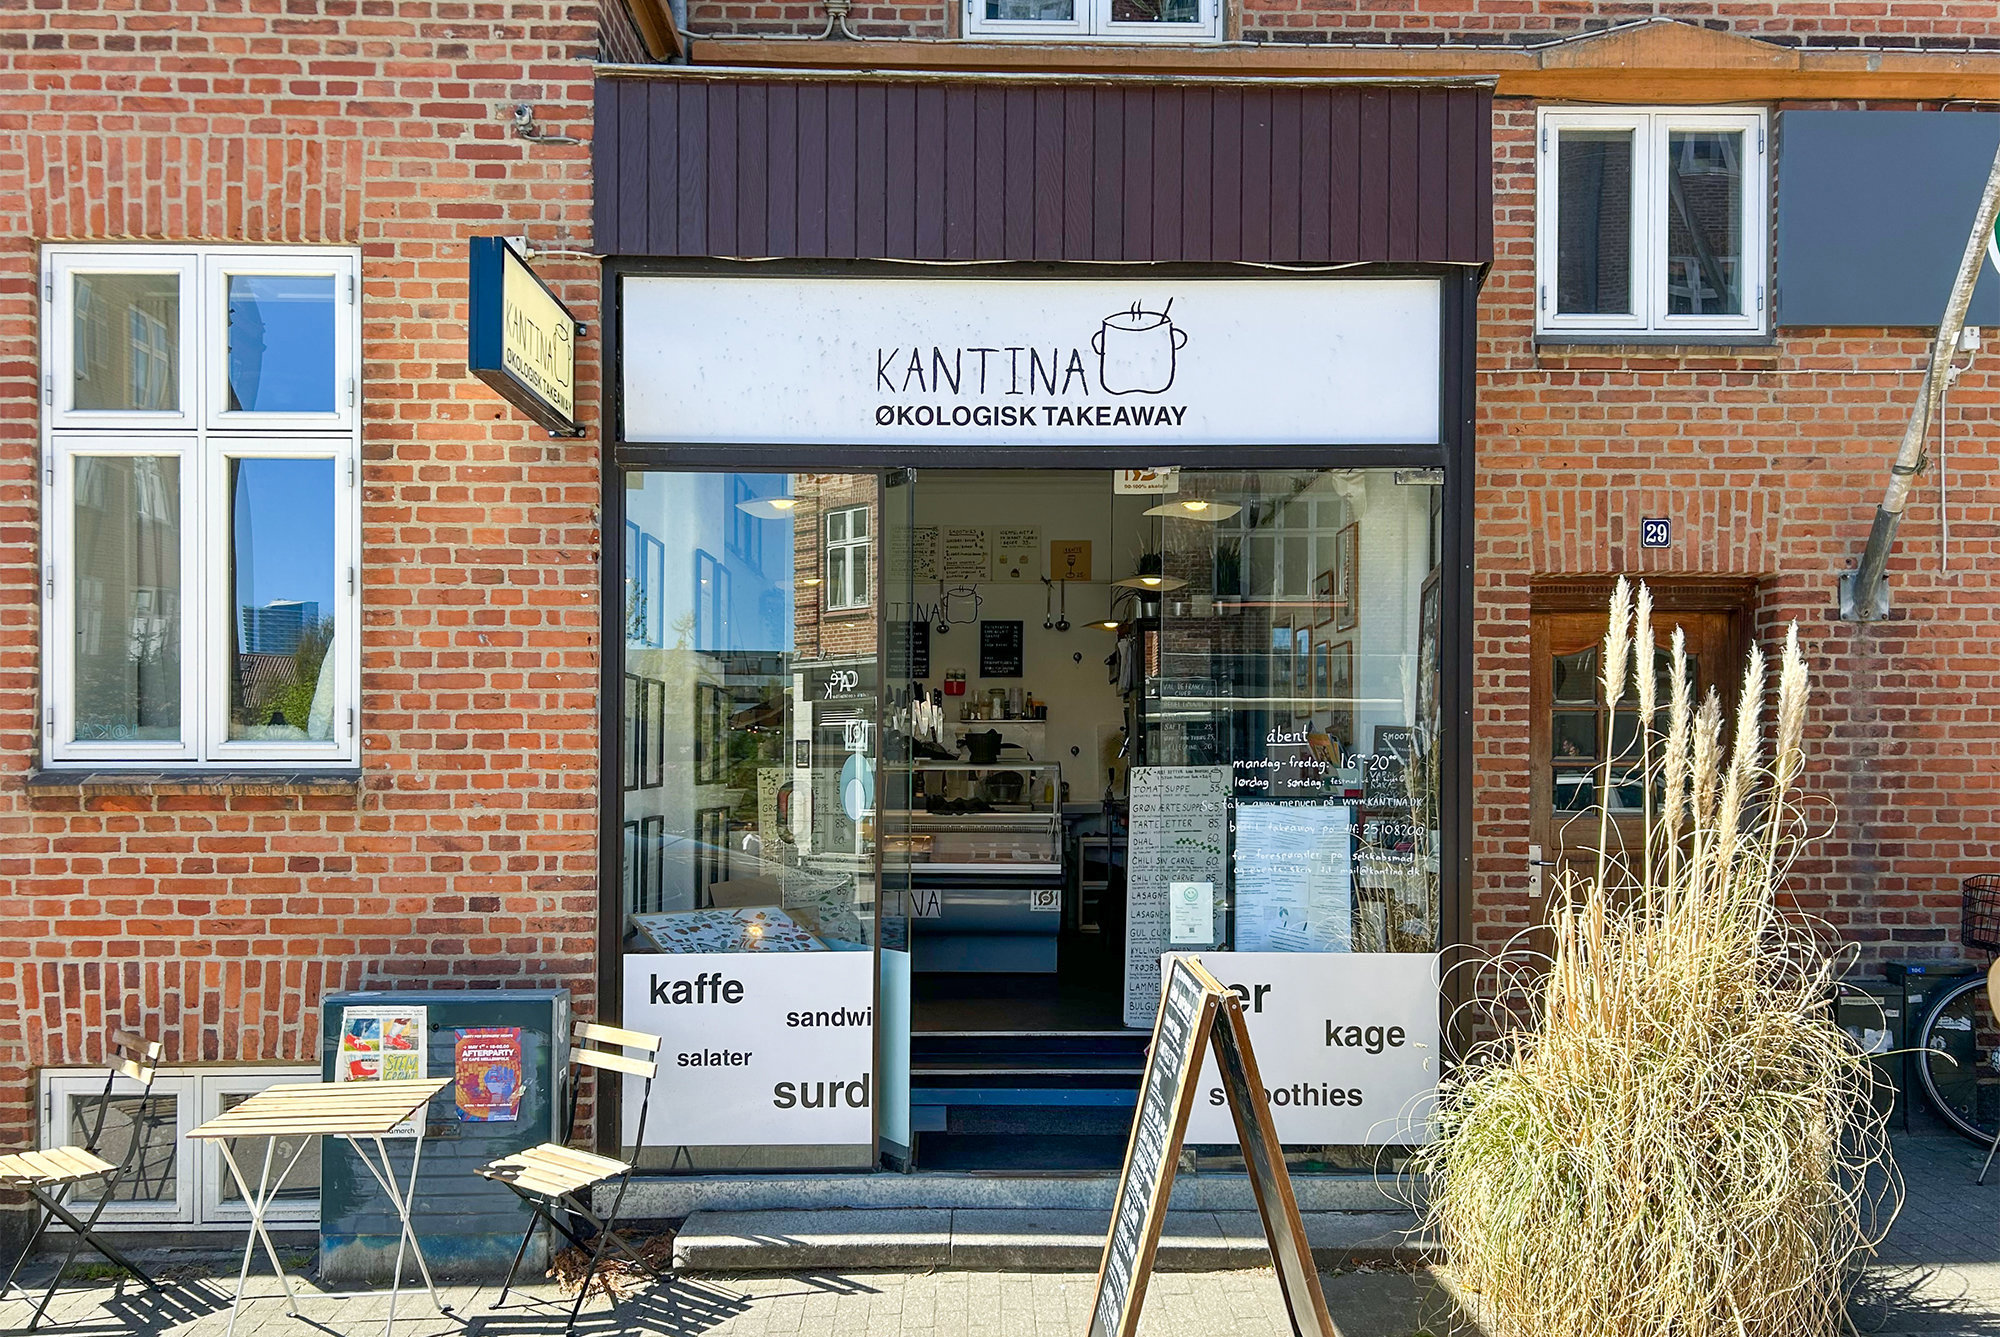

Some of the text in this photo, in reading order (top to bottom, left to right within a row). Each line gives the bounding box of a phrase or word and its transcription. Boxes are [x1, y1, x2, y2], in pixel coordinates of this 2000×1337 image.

[506, 299, 554, 376] KANTINA
[506, 347, 573, 416] ØKOLOGISK TAKEAWAY
[876, 346, 1089, 396] KANTINA
[875, 404, 1188, 427] ØKOLOGISK TAKEAWAY
[1645, 523, 1668, 543] 29
[1266, 724, 1308, 743] åbent
[1234, 776, 1269, 789] lørdag
[1287, 777, 1325, 789] søndag:
[1170, 856, 1195, 865] CARNE
[1171, 873, 1195, 882] CARNE
[1131, 891, 1168, 900] LASAGNE
[1130, 928, 1146, 938] GUL
[650, 972, 745, 1005] kaffe
[786, 1006, 872, 1028] sandwi
[1325, 1020, 1406, 1054] kage
[462, 1048, 515, 1057] AFTERPARTY
[677, 1048, 753, 1067] salater
[773, 1073, 870, 1109] surd
[1209, 1082, 1363, 1107] sothies
